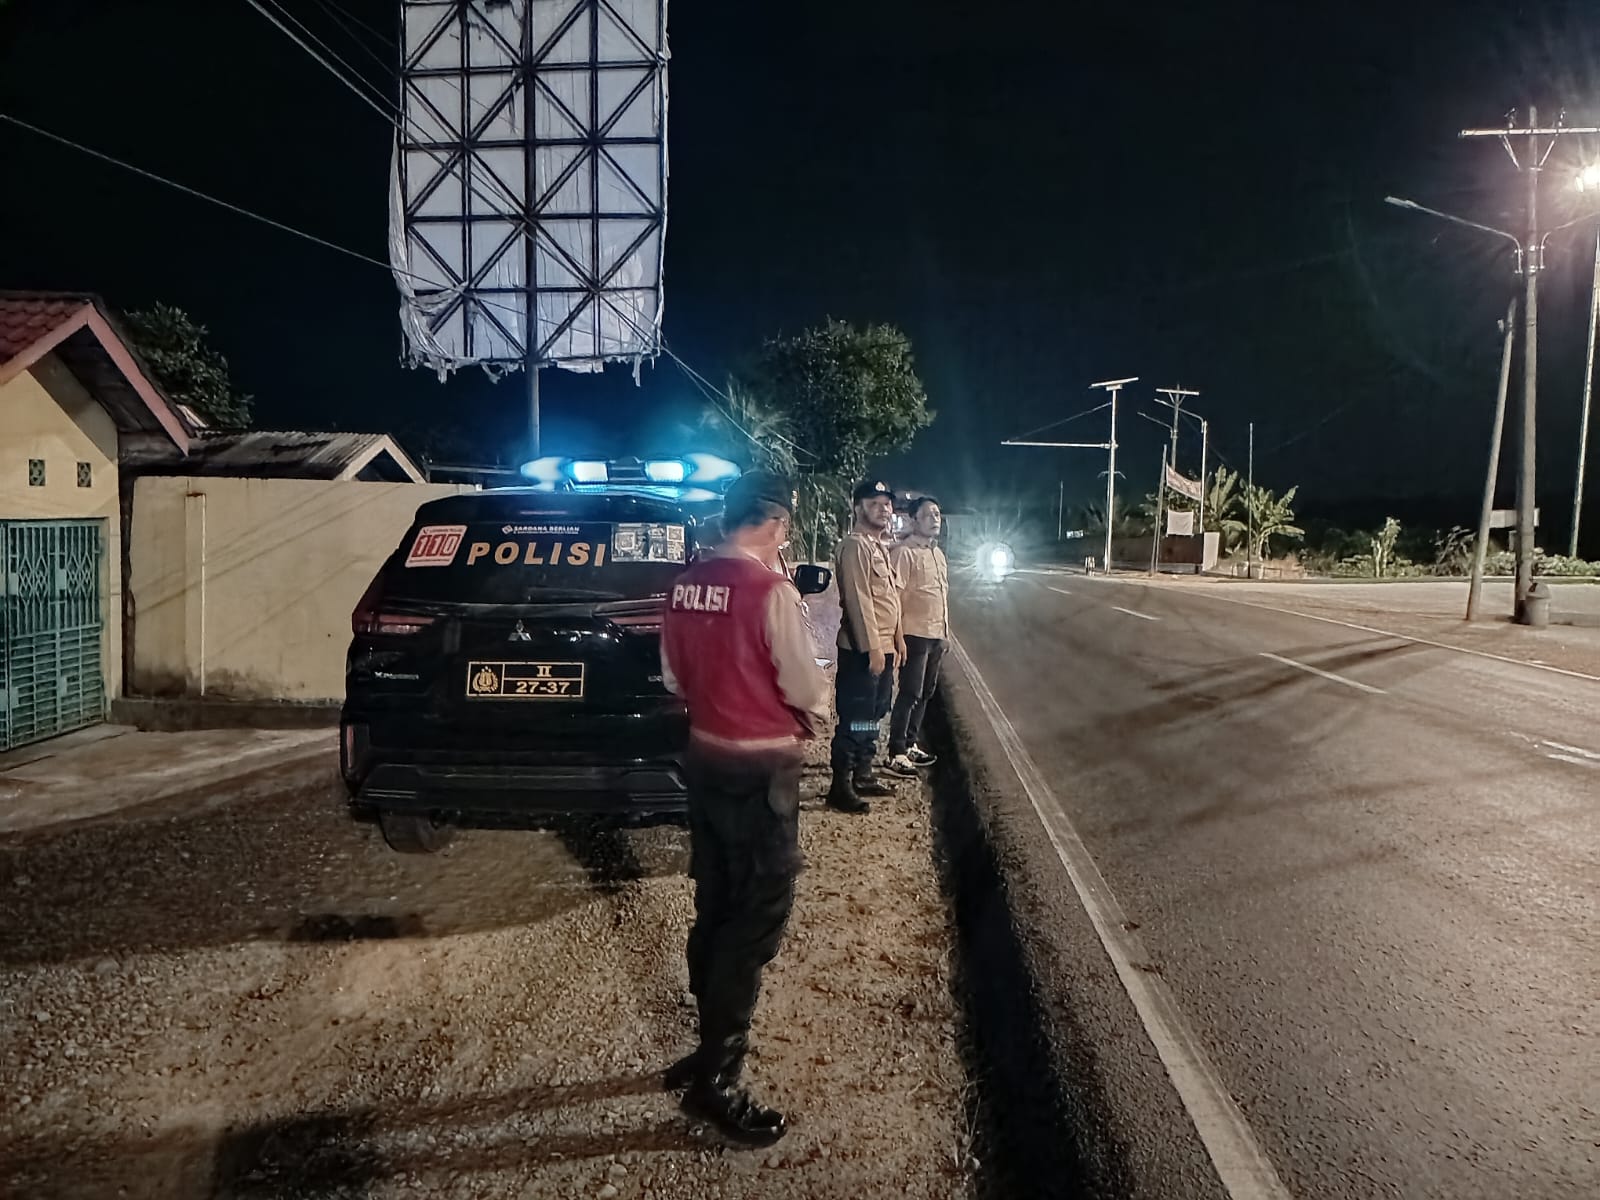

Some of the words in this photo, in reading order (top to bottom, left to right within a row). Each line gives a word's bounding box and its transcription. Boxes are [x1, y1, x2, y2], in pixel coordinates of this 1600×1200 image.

[412, 534, 461, 557] 110
[466, 541, 606, 567] POLISI
[672, 584, 730, 612] POLISI
[536, 665, 552, 678] II
[515, 681, 570, 694] 27-37
